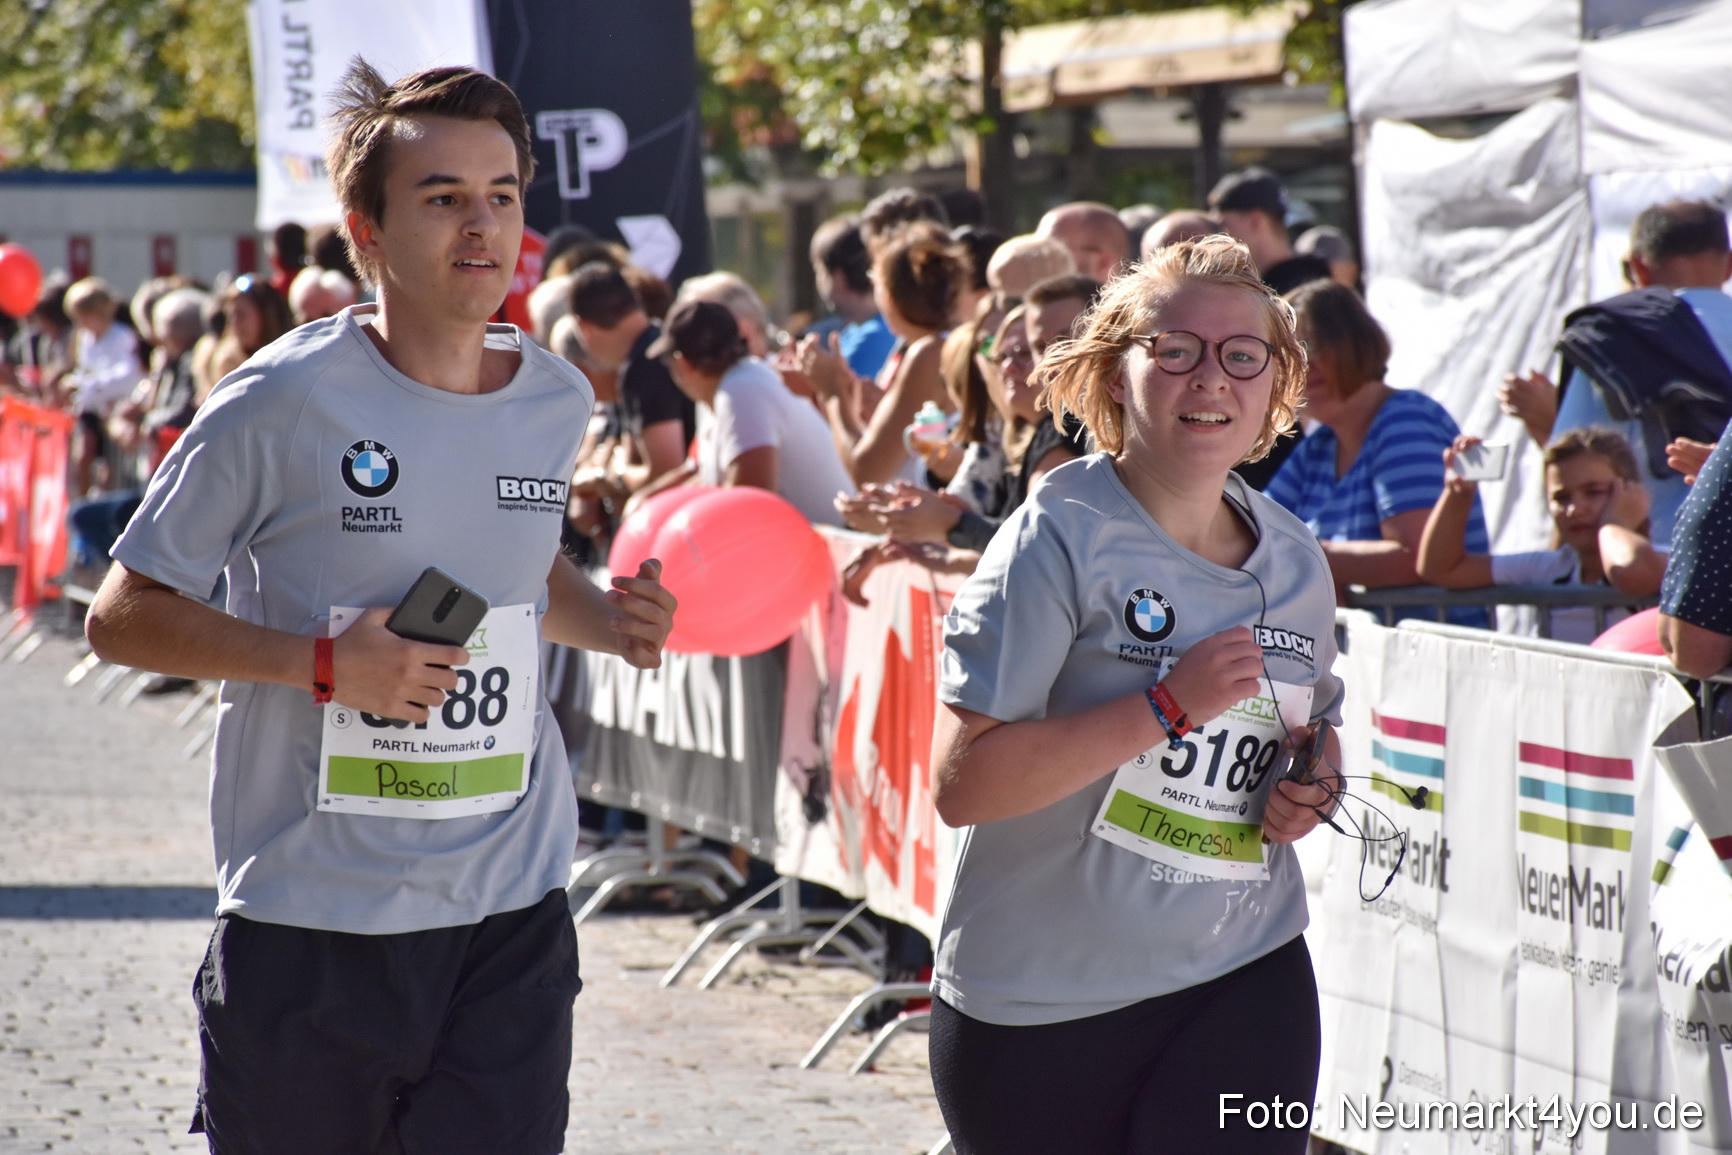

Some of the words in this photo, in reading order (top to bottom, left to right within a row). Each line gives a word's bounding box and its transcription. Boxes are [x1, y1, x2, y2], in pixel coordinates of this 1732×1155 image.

[346, 441, 394, 461] BMW
[497, 477, 566, 506] BOCK
[341, 506, 403, 522] PARTL
[497, 502, 528, 512] inspired
[529, 504, 538, 514] by
[342, 521, 402, 533] Neumarkt
[1130, 589, 1171, 609] BMW
[1253, 625, 1314, 662] BOCK
[337, 712, 346, 724] S
[372, 738, 419, 753] PARTL
[422, 739, 480, 753] Neumarkt
[1137, 754, 1146, 765] S
[1160, 725, 1280, 794] 5189
[375, 762, 458, 798] Pascal
[1160, 786, 1202, 809] PARTL
[1204, 799, 1239, 814] Neumarkt
[1137, 804, 1234, 856] Theresa
